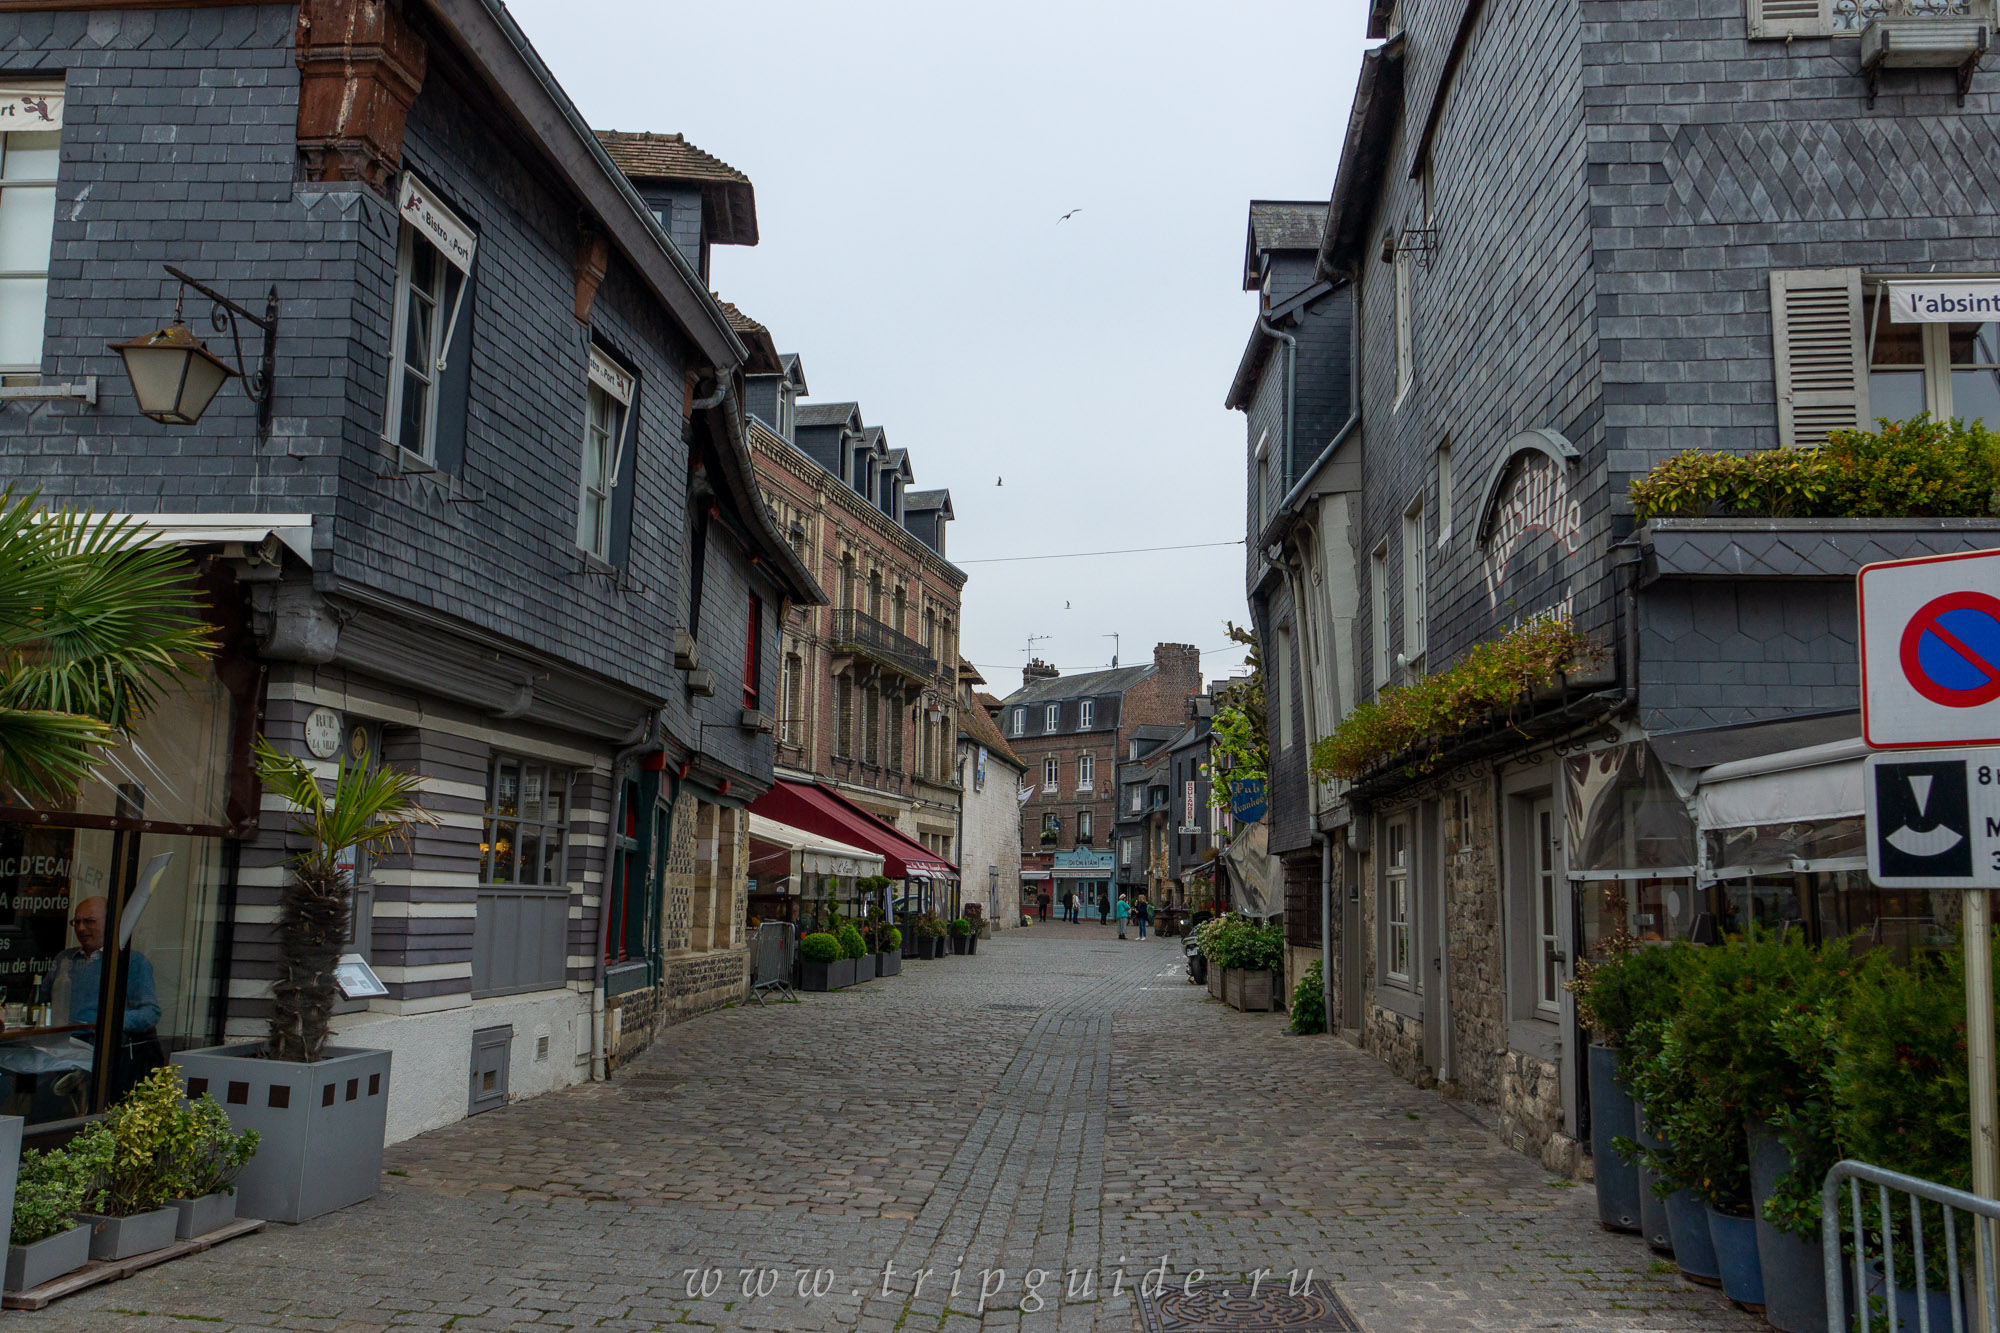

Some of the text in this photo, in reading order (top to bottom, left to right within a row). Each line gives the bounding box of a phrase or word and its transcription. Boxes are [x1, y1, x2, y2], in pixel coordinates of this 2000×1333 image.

[426, 211, 448, 242] Bistro
[453, 238, 469, 261] Port
[316, 714, 334, 728] RUE
[312, 739, 335, 750] LA VILLE
[1233, 781, 1260, 794] Pub
[12, 956, 26, 974] de
[29, 956, 57, 974] fruits
